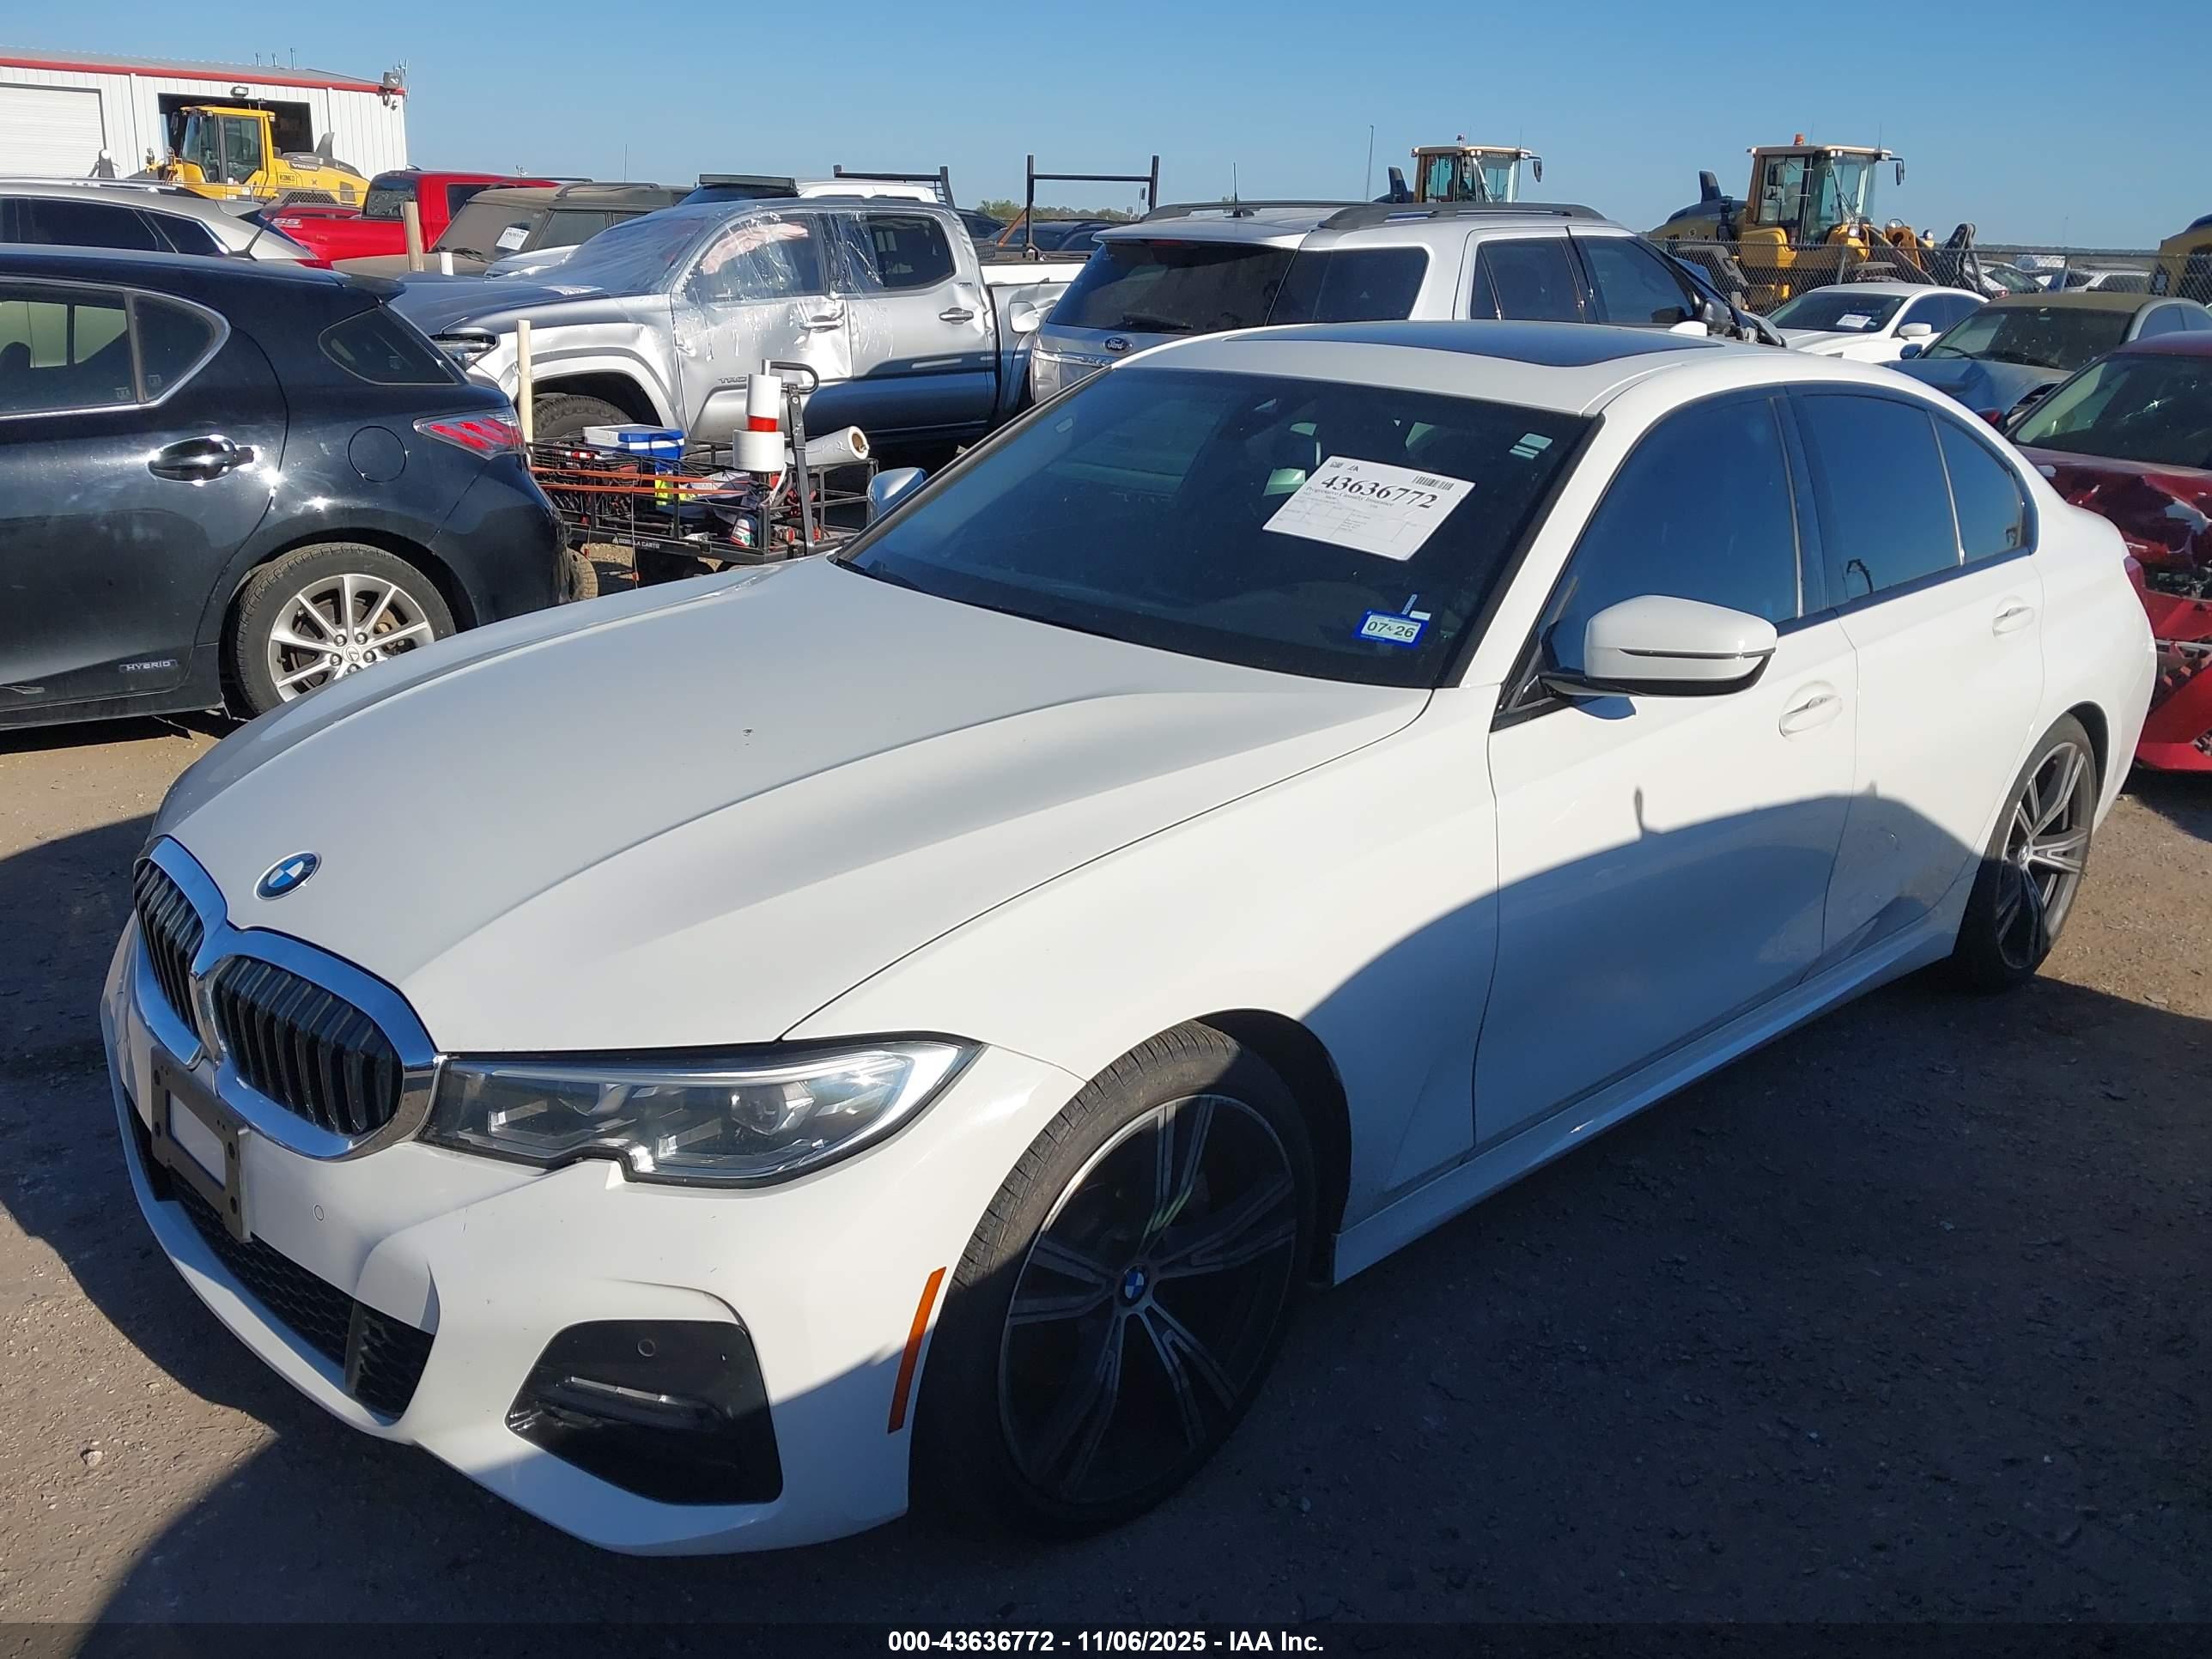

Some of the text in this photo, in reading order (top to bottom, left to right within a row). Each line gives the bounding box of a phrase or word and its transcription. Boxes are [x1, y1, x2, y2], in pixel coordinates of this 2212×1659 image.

[1108, 338, 1124, 349] Ford
[1321, 475, 1438, 509] 43636772
[1367, 621, 1388, 633] 07
[1394, 625, 1415, 638] 26
[126, 660, 171, 672] HYBRID
